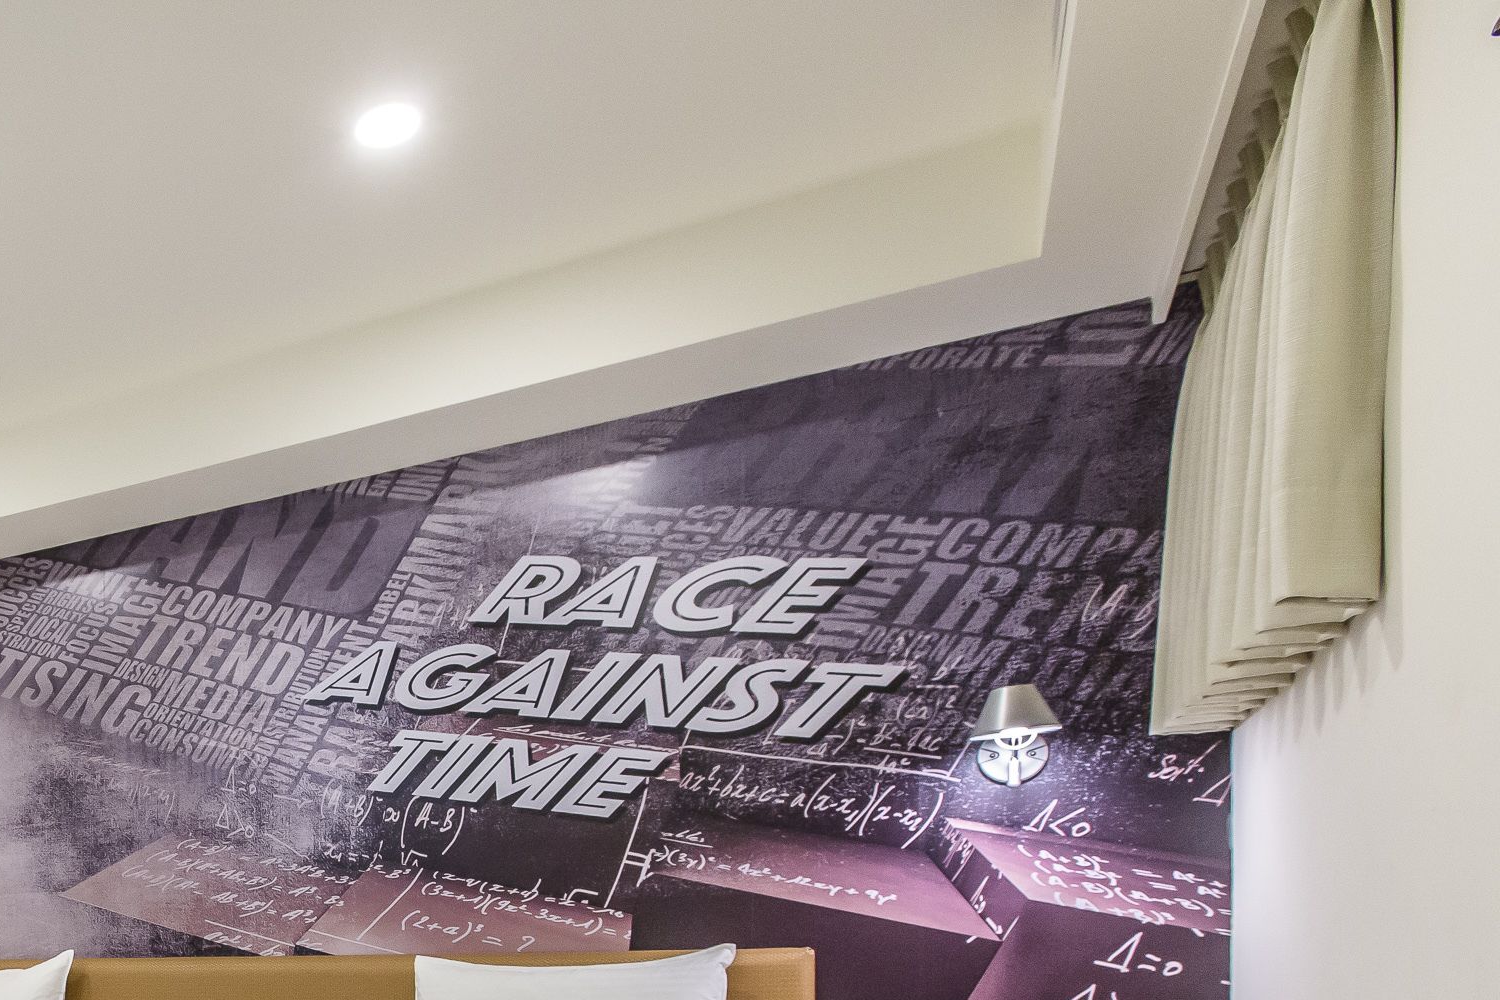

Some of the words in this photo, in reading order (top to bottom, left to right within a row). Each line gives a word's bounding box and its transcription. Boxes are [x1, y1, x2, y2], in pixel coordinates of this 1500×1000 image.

[720, 506, 891, 553] VALUE
[935, 518, 1165, 575] COMPA
[36, 604, 88, 624] LOYALTY
[43, 561, 140, 604] VALUE
[44, 588, 97, 613] RIGHTS
[367, 572, 412, 625] LABEL
[468, 555, 870, 635] RACE
[20, 613, 78, 646] LOCAL
[58, 599, 118, 665] FOCUS
[80, 578, 174, 675] IMAGE
[161, 585, 348, 649] COMPANY
[113, 658, 171, 689] DESIGN
[134, 613, 304, 696] TREND
[151, 668, 276, 733] MEDIA
[254, 646, 333, 757] DISTRIBUTION
[261, 619, 379, 791] MANAGENT
[301, 641, 907, 738] AGAINST
[143, 702, 260, 752] ORIENTATION
[366, 729, 679, 819] TIME
